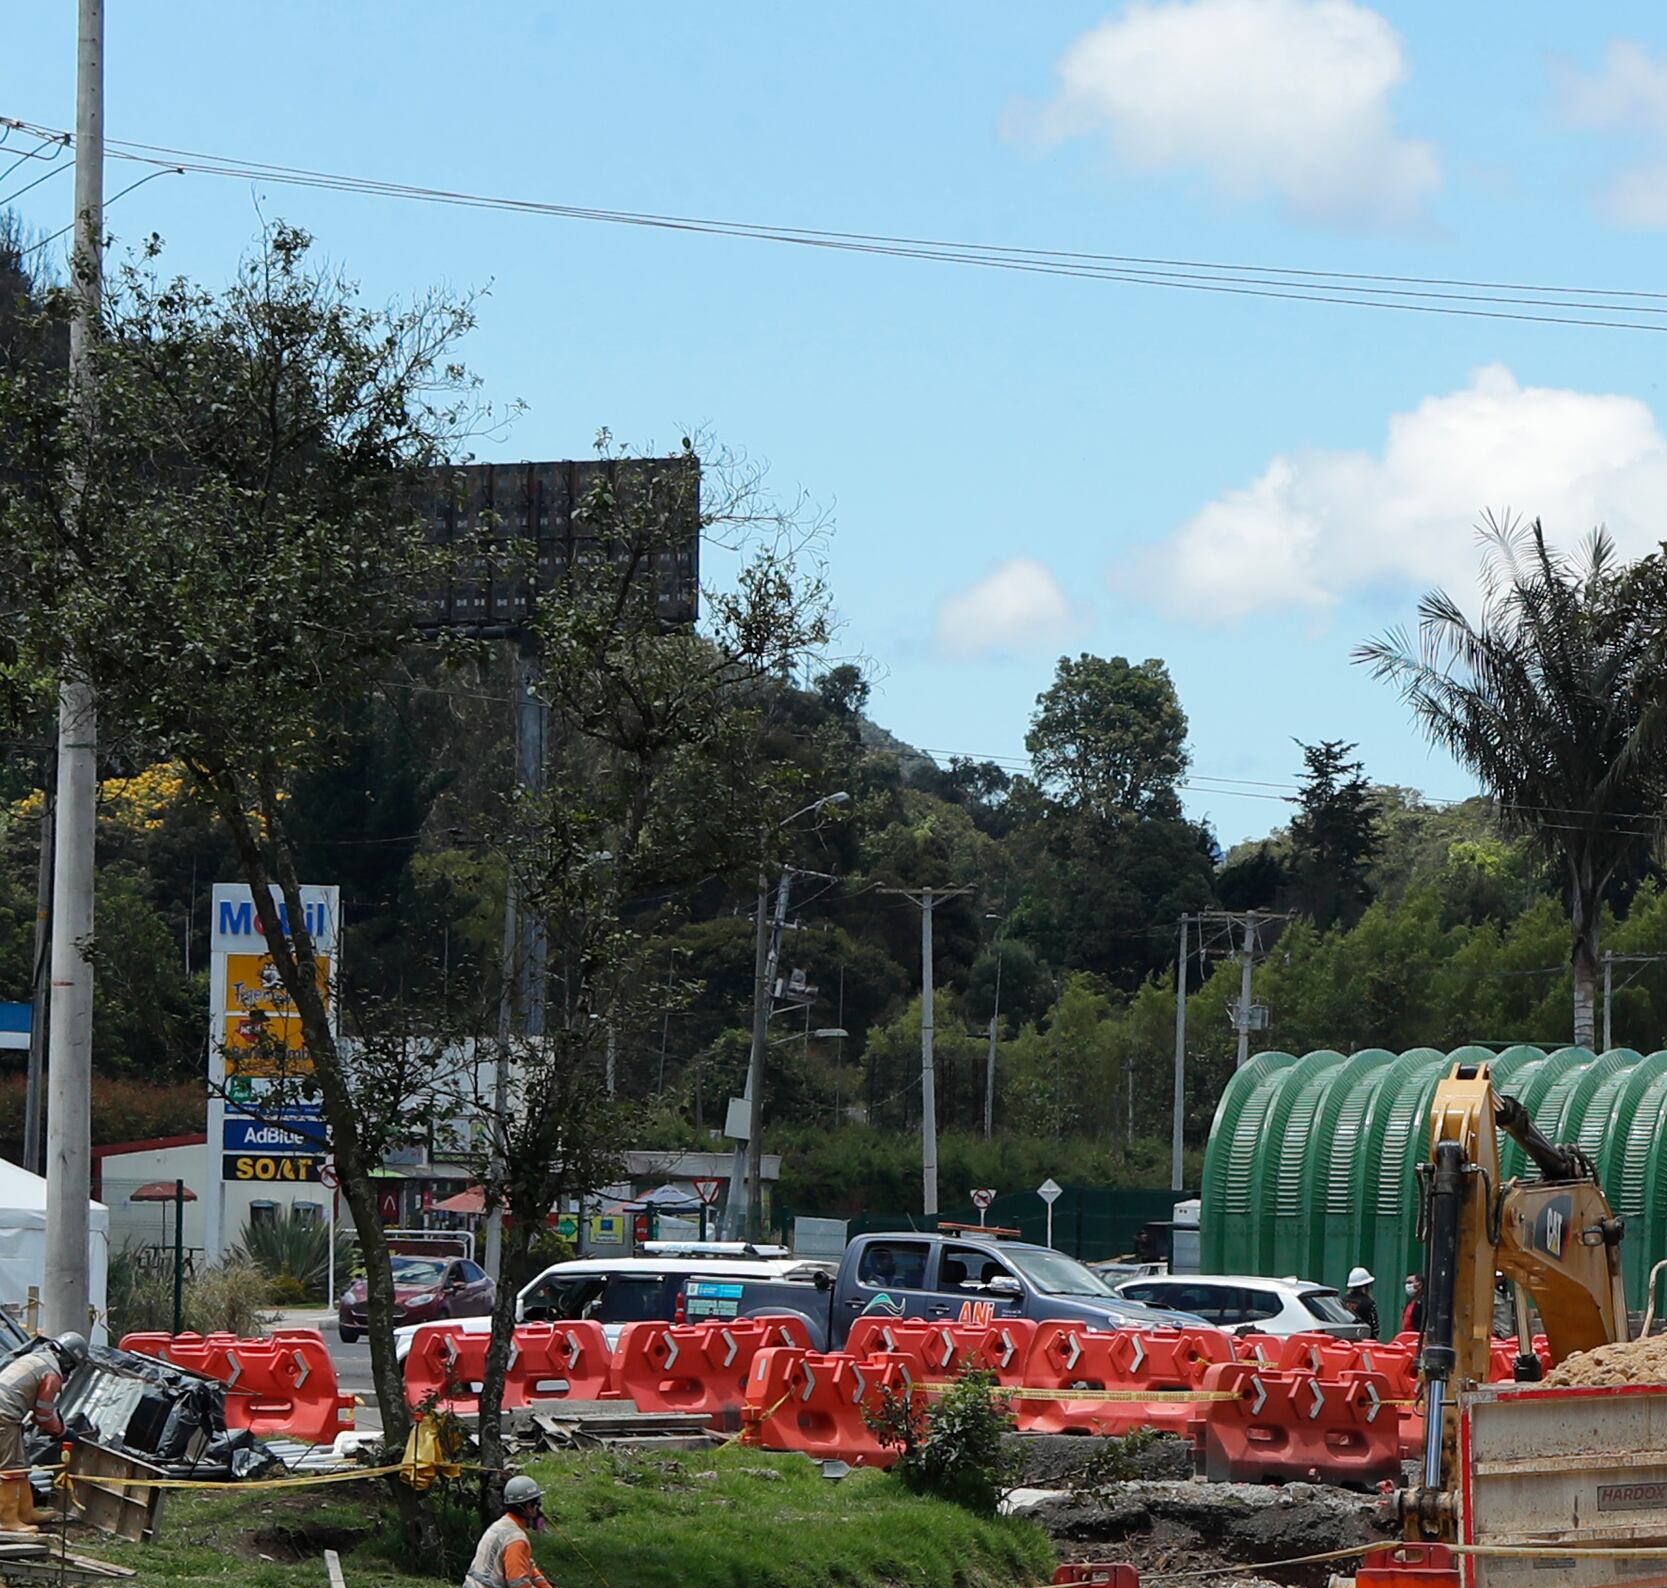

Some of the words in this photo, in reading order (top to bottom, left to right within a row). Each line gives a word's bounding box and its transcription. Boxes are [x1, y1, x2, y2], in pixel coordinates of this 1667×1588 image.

[243, 1126, 305, 1144] AdBlue
[236, 1157, 313, 1180] SOAT
[1546, 1207, 1563, 1257] CAT
[1601, 1485, 1666, 1502] HARDOX
